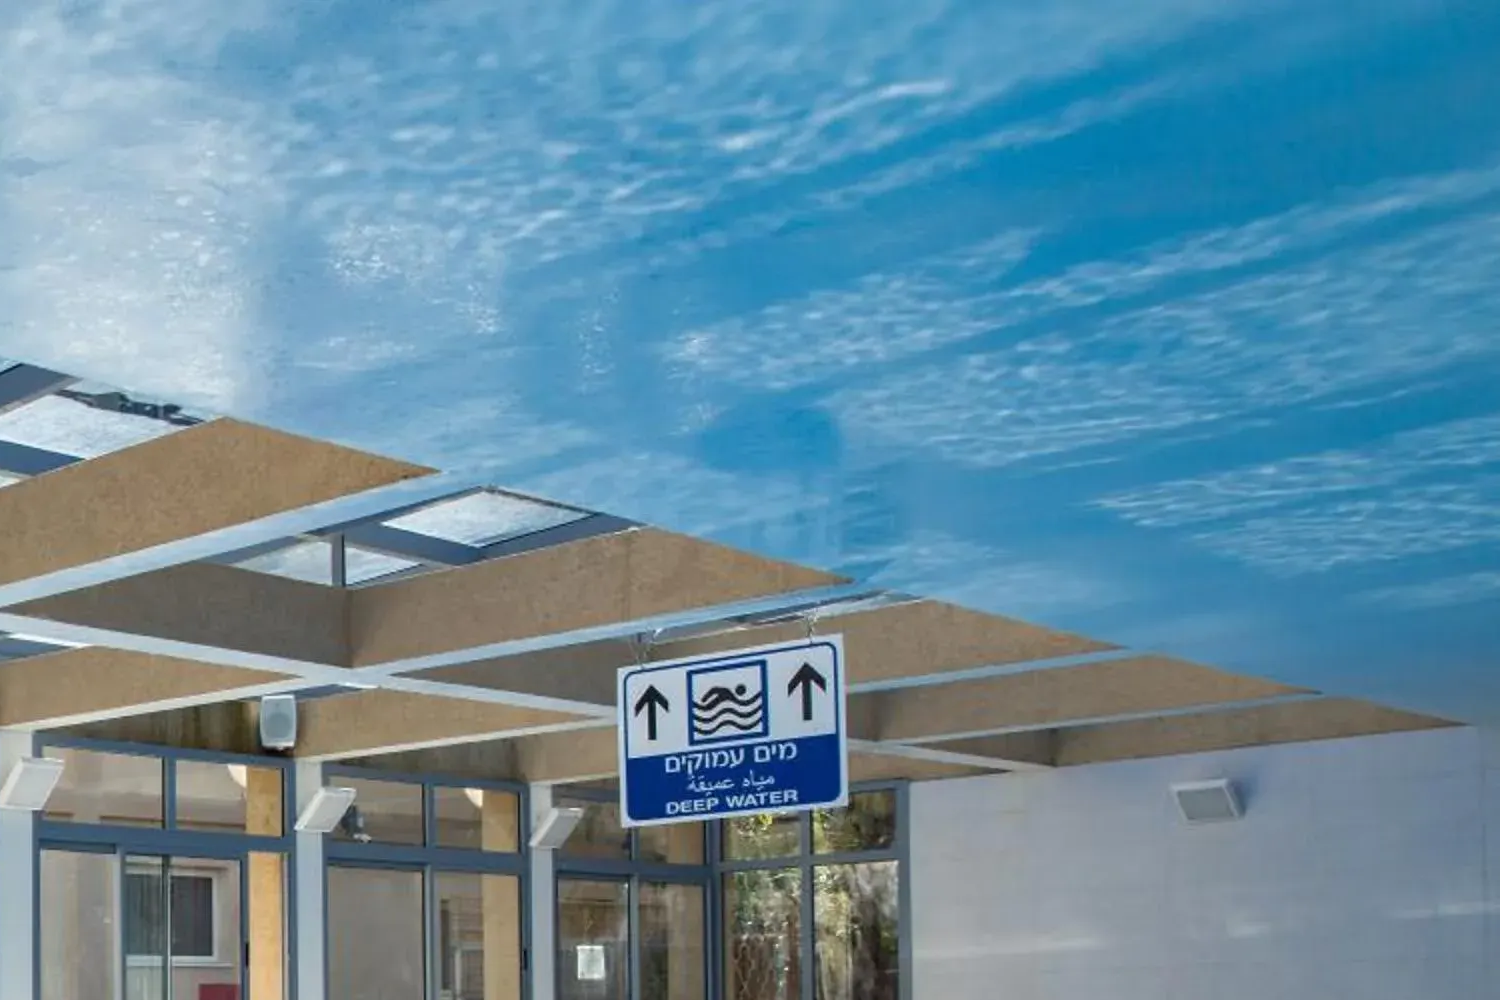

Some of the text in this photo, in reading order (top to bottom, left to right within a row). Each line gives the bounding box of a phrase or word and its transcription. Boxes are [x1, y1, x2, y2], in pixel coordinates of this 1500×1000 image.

[664, 741, 798, 775] מים עמוקים
[665, 789, 799, 815] DEEP WATER
